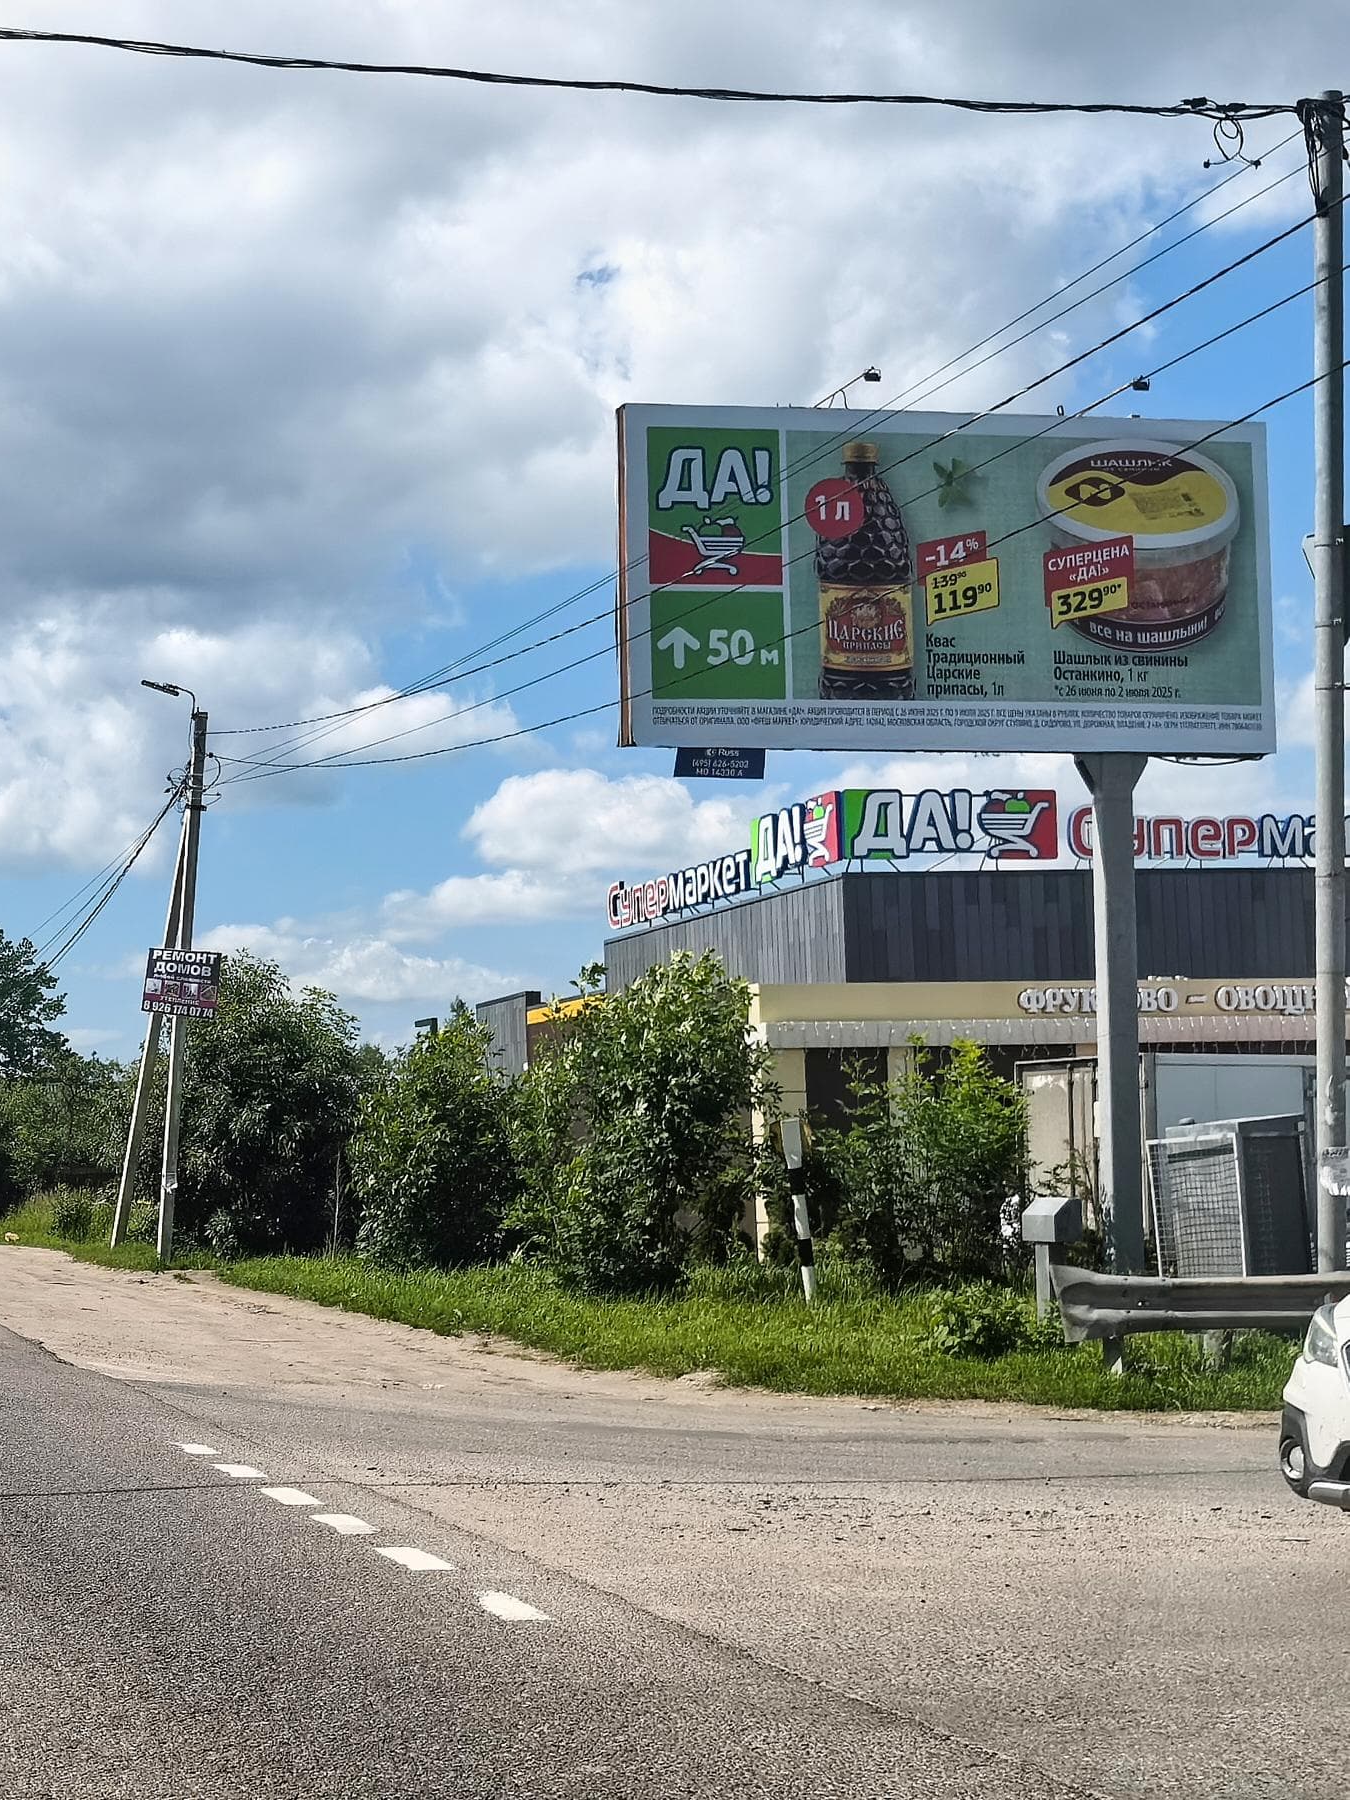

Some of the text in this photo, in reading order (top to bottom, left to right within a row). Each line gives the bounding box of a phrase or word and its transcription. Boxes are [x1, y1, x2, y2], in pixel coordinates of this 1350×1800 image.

[657, 447, 773, 510] ДА!
[815, 495, 826, 521] 1
[1048, 544, 1130, 572] СУПЕРЦЕНА
[827, 617, 905, 642] ЦАРСКИЕ
[1115, 628, 1133, 642] на
[708, 629, 755, 665] 50
[843, 641, 891, 650] ПРИПАСЫ
[925, 633, 956, 648] Квас
[925, 650, 1025, 666] Традиционный
[1053, 651, 1188, 667] Шашлык из свинины
[926, 666, 981, 681] Царские
[1053, 667, 1149, 683] Останкино, 1 кг
[927, 683, 988, 699] припасы,
[1065, 685, 1077, 697] 26
[1078, 687, 1105, 697] июня
[1105, 687, 1116, 698] по
[1118, 686, 1124, 698] 2
[1126, 687, 1150, 698] июля
[1151, 686, 1173, 698] 2025
[718, 749, 739, 757] Russ
[850, 789, 975, 860] ДА!
[607, 802, 805, 930] Супермаркет ДА!
[152, 949, 217, 965] РЕМОНТ
[153, 961, 212, 977] ДОМОВ
[143, 1000, 151, 1010] 8
[152, 1001, 171, 1013] 926
